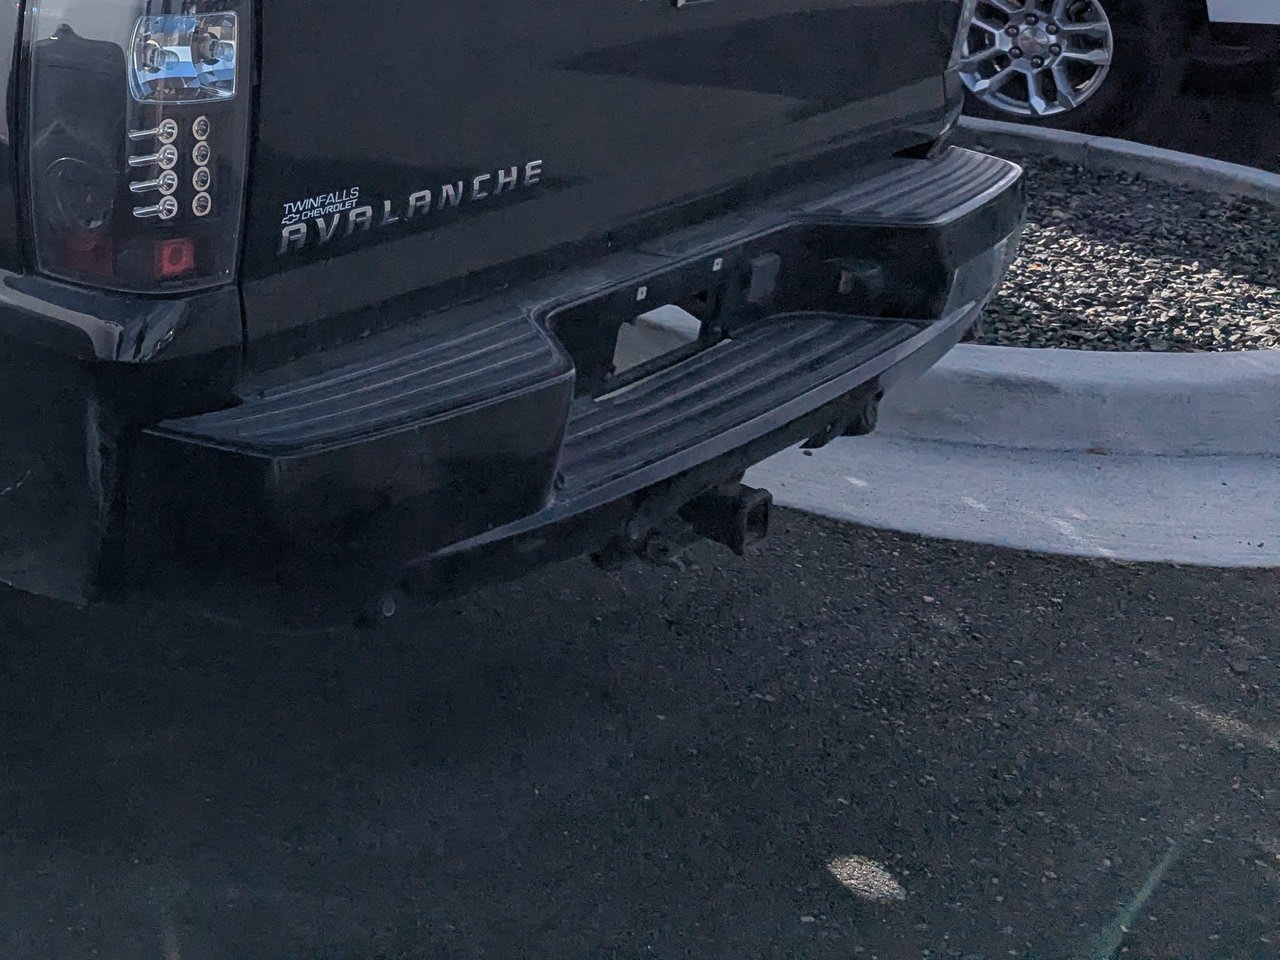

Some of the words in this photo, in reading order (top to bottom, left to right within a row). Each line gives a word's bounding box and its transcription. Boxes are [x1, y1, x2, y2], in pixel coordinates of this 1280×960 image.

[276, 159, 543, 257] AVALANCHE
[283, 186, 360, 215] TWINFALLS
[301, 199, 358, 221] CHEVROLET
